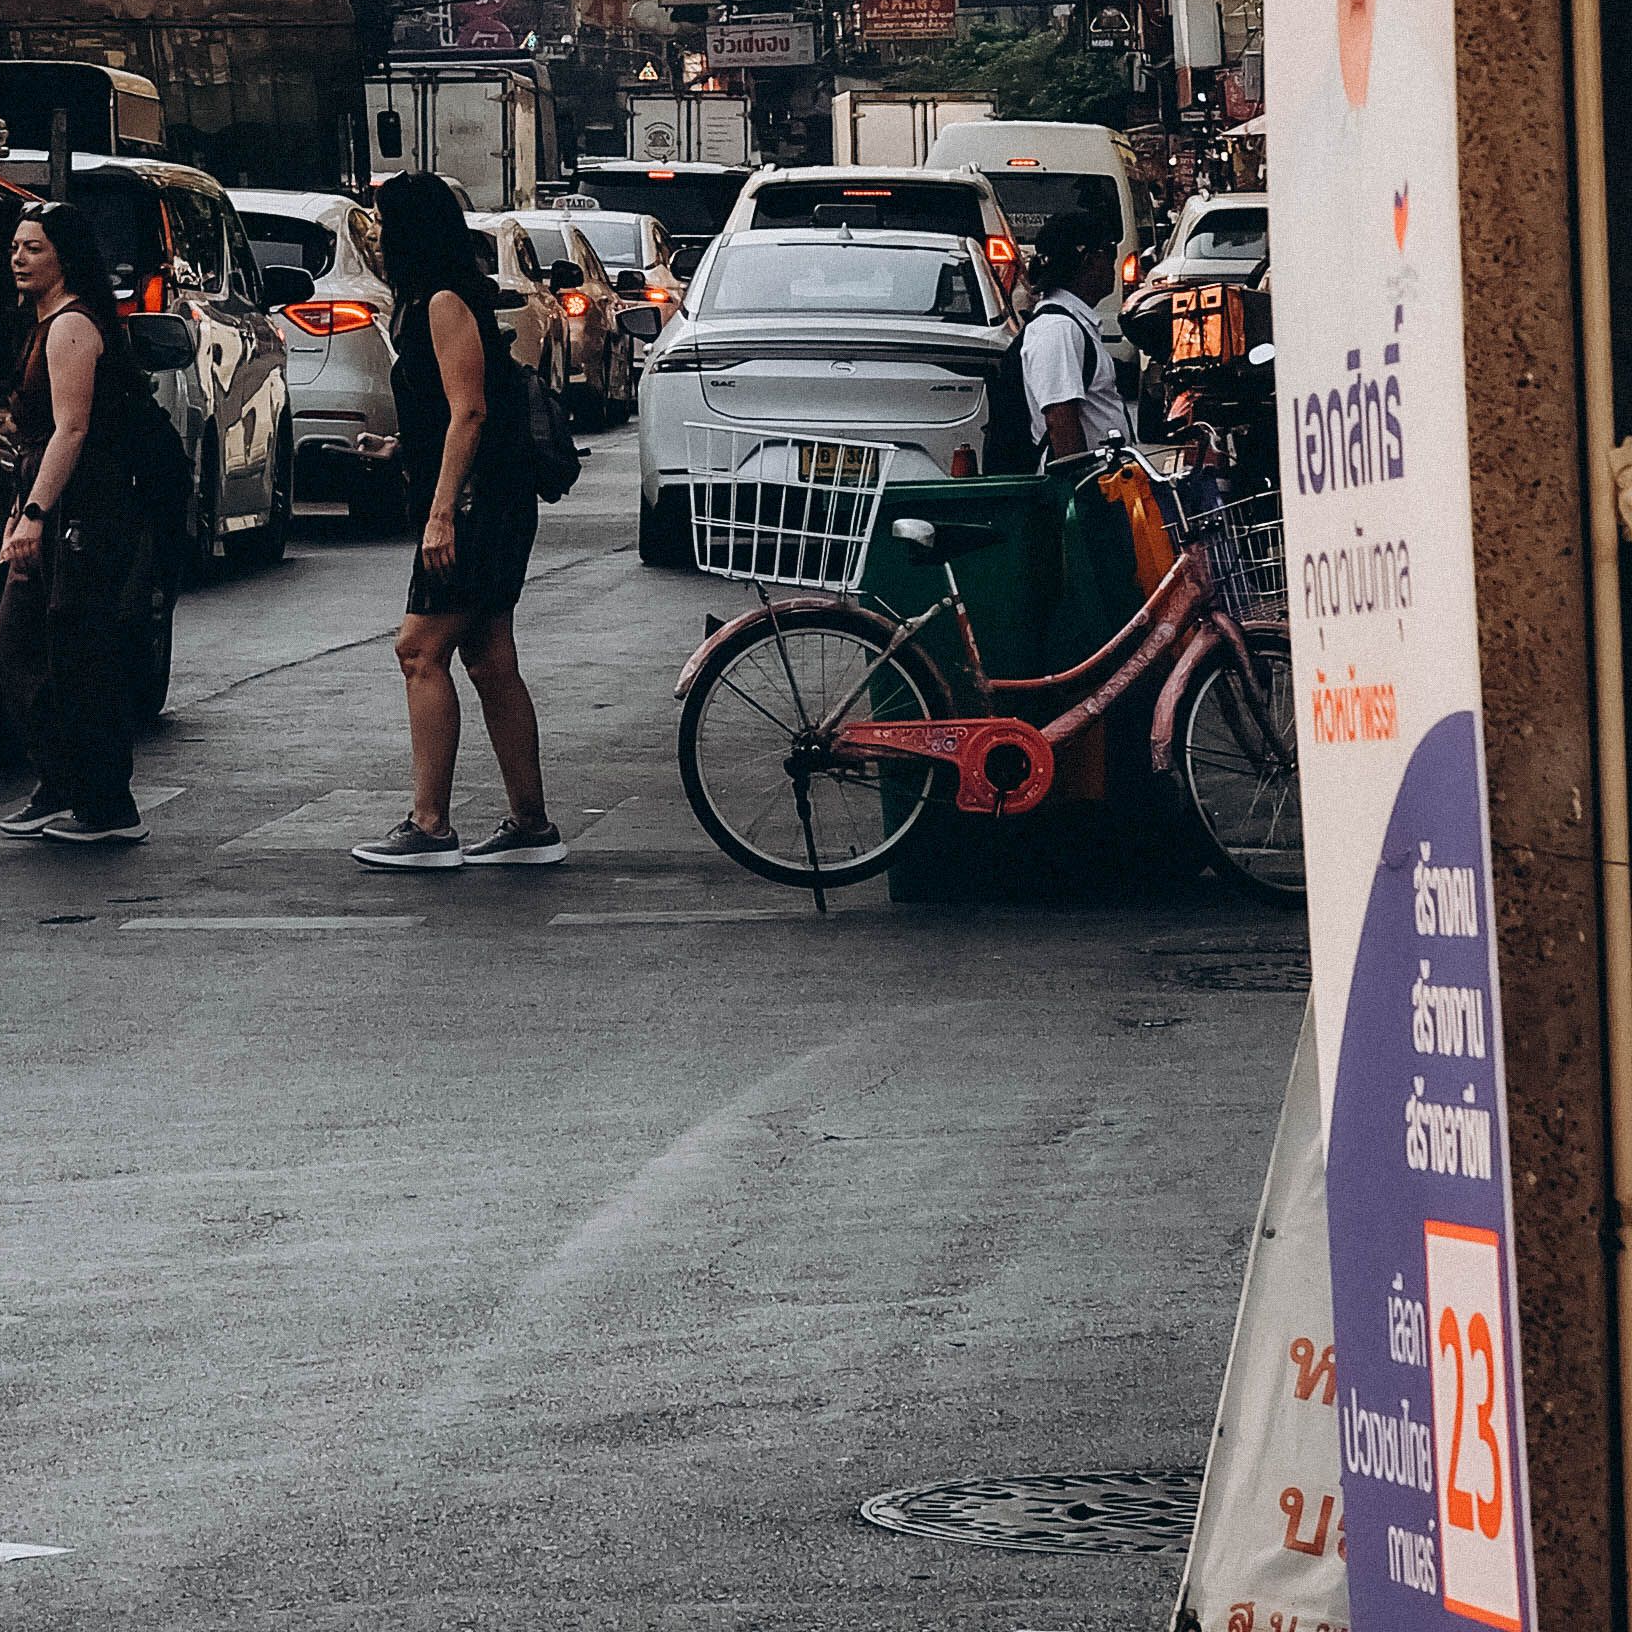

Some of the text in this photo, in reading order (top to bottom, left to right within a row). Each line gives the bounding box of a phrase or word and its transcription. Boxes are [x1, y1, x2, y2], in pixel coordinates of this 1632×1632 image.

[1311, 663, 1399, 744] หัวหน้าพรรค
[1413, 840, 1479, 937] สร้างคน
[1411, 958, 1487, 1060] สร้างงาน
[1405, 1074, 1492, 1181] สร้างอาชีพ
[1387, 1271, 1427, 1369] เลือก
[1438, 1305, 1503, 1541] 23
